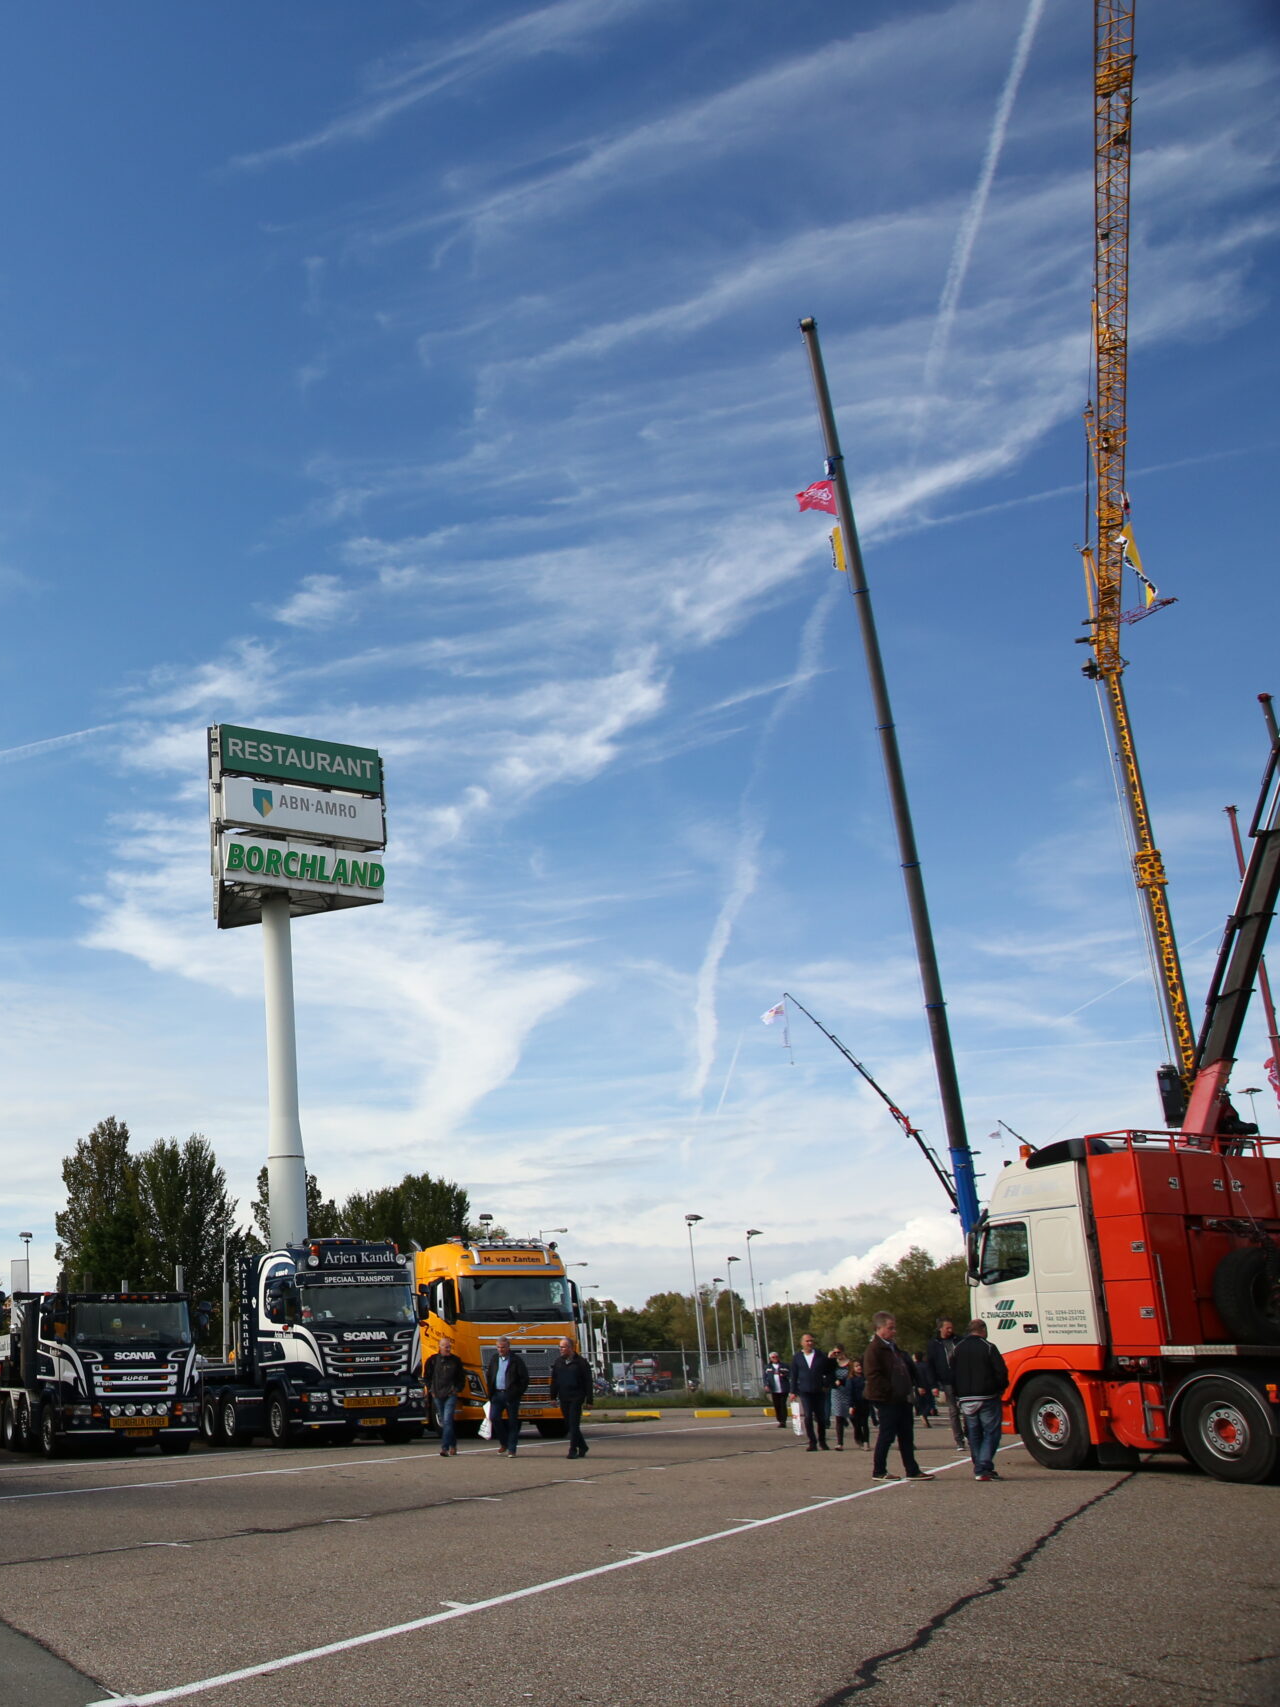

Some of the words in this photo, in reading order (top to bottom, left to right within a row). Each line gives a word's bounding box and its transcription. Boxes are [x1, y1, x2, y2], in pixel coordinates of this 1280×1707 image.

[228, 738, 373, 779] RESTAURANT
[225, 842, 385, 889] BORCHLAND
[324, 1251, 357, 1265] Arjen
[360, 1251, 395, 1263] Kandt
[241, 1263, 249, 1304] Arjen
[324, 1276, 356, 1284] SPECIAAL
[357, 1275, 394, 1283] TRANSPORT
[242, 1313, 250, 1356] Kandt
[343, 1331, 388, 1341] SCANIA
[114, 1351, 157, 1360] SCANIA
